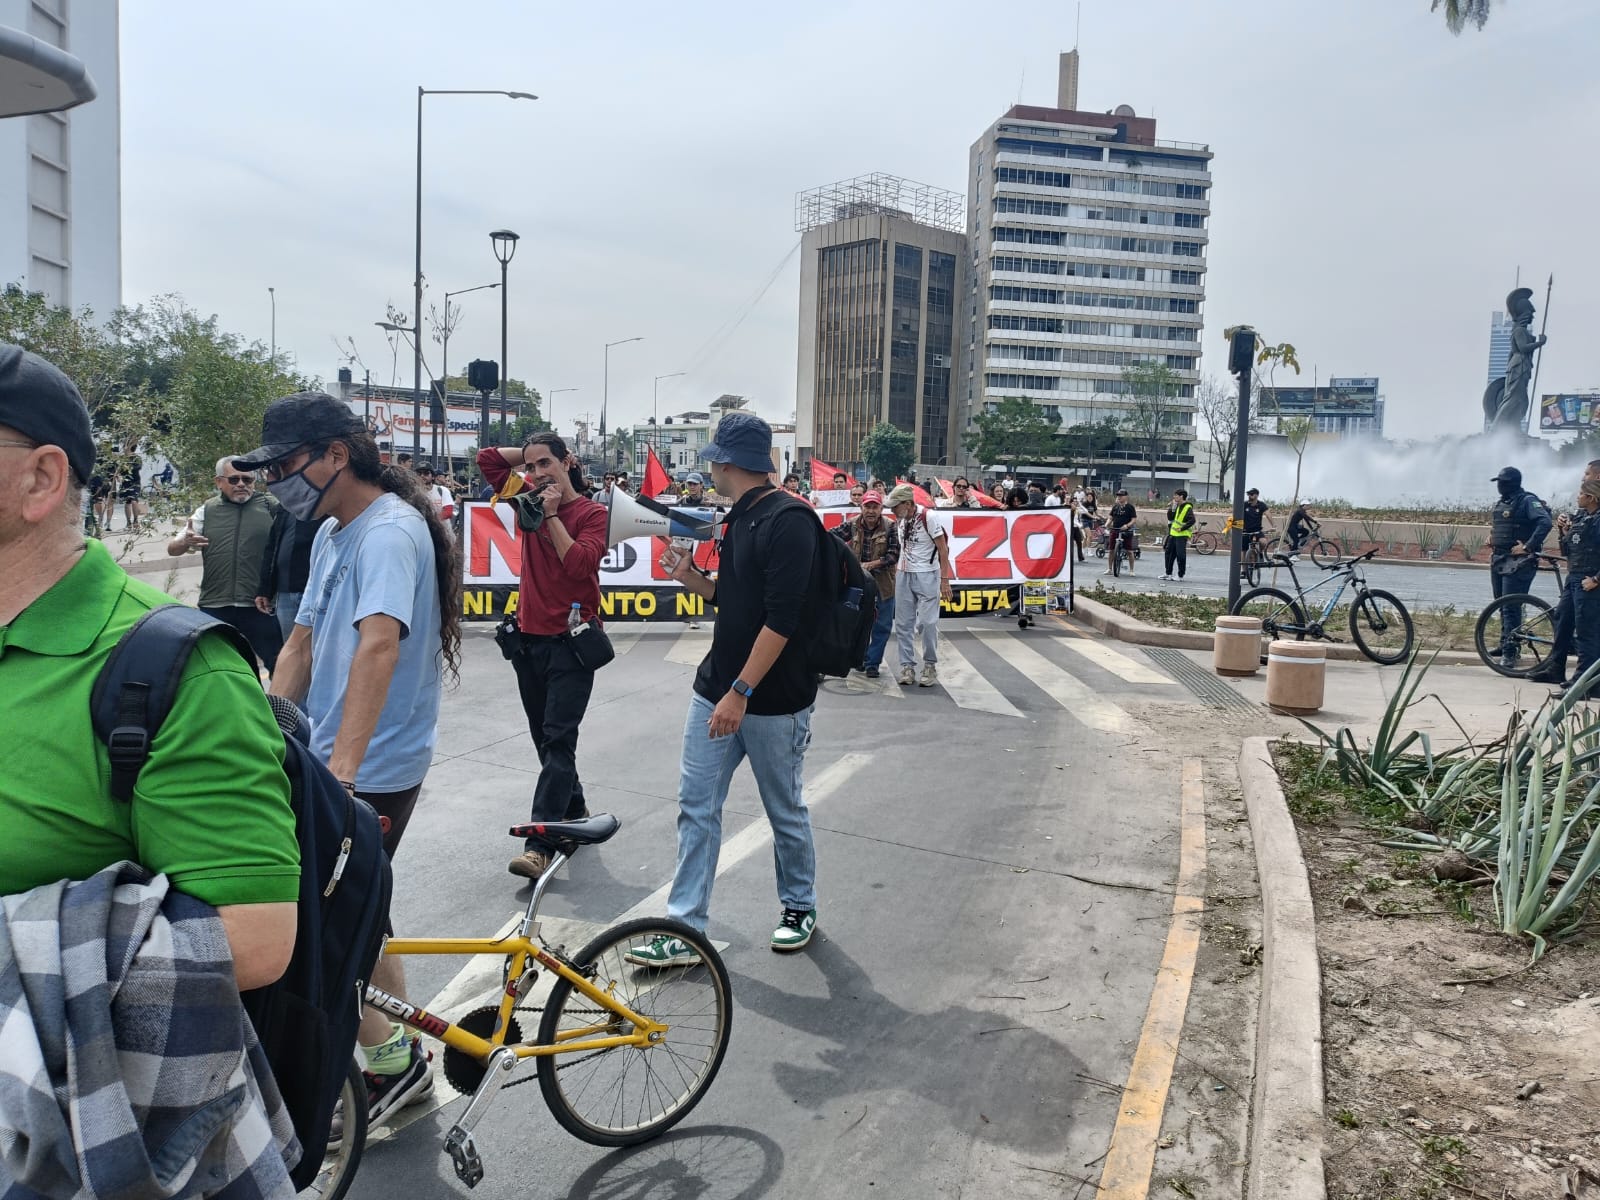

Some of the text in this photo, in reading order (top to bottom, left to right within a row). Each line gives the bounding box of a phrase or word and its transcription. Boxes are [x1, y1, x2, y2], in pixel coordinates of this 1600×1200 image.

[600, 542, 625, 568] al
[463, 591, 492, 615] NI
[676, 592, 704, 616] NI
